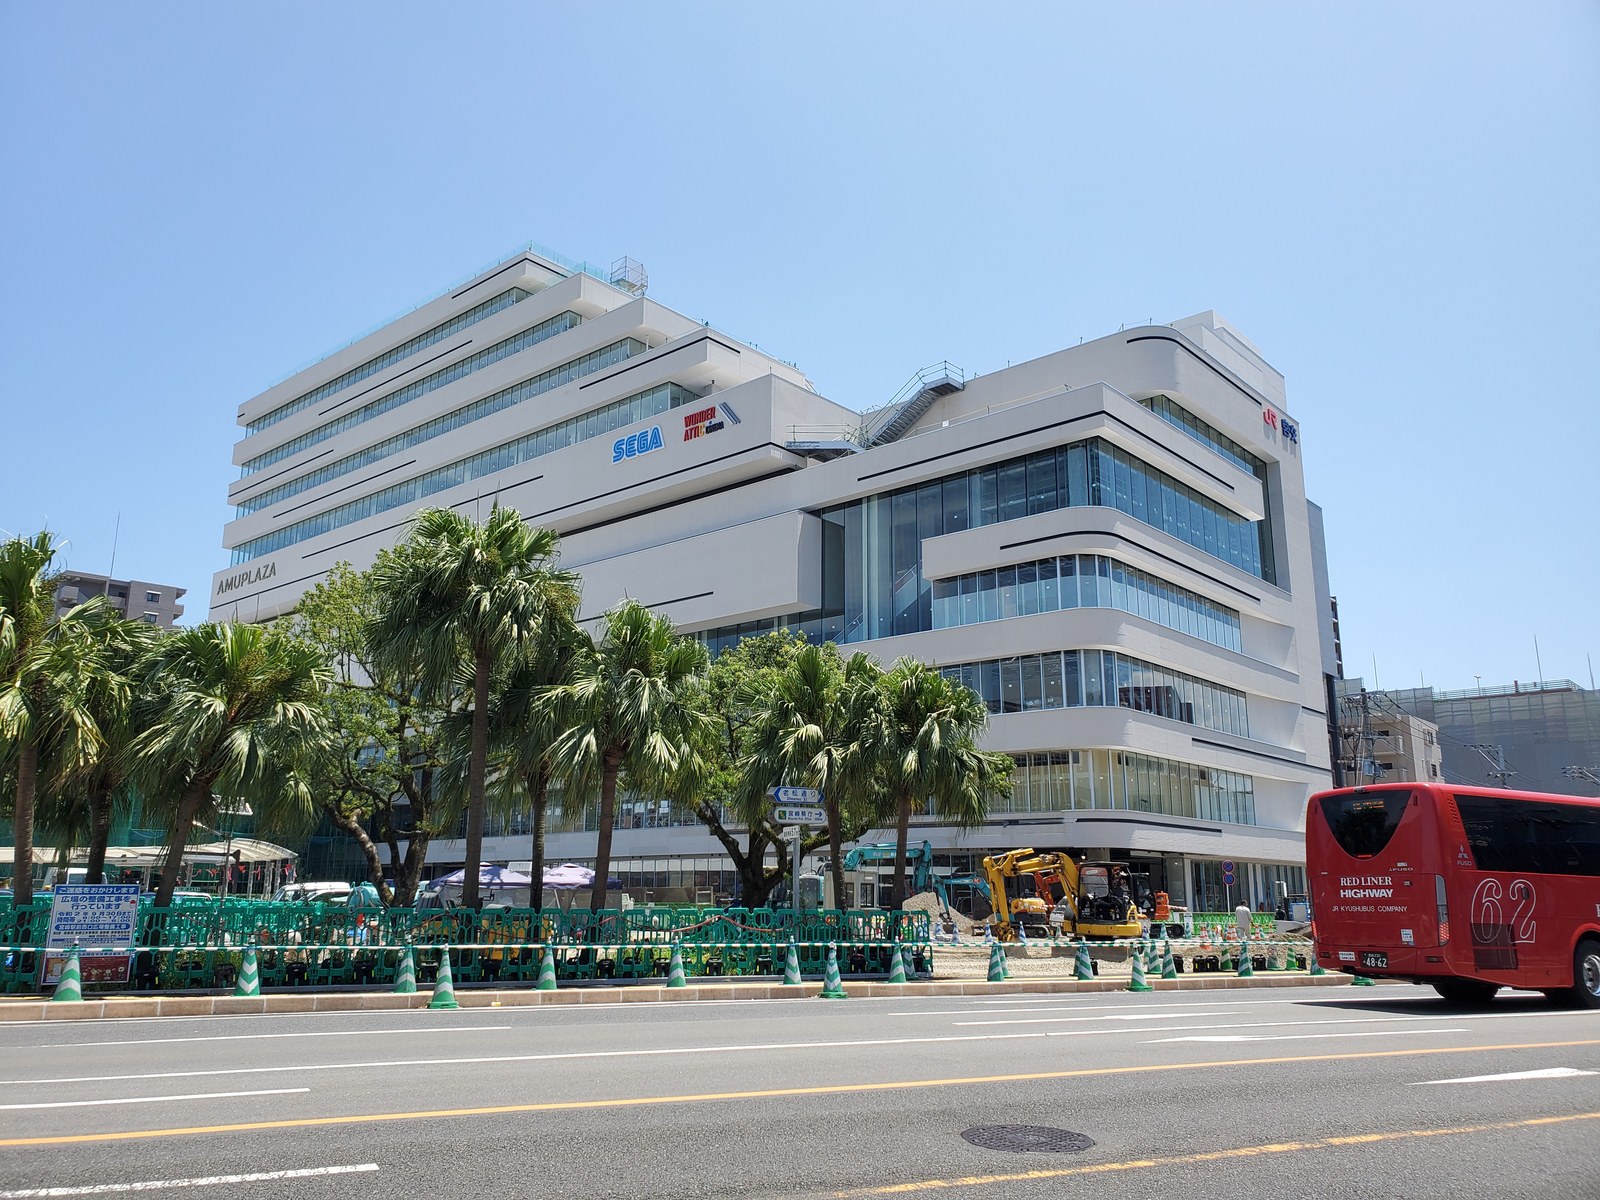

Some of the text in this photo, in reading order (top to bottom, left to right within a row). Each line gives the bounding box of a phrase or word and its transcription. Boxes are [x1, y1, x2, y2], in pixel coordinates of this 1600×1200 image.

[684, 406, 716, 428] WONDER
[1263, 409, 1277, 430] JR
[684, 423, 705, 442] ATTIC
[612, 425, 665, 464] SEGA
[217, 562, 276, 595] AMUPLAZA
[783, 789, 816, 797] 老松通り
[1340, 877, 1360, 886] RED
[1361, 876, 1393, 886] LINER
[61, 895, 131, 903] 広場の整備工事を
[1340, 889, 1393, 898] HIGHWAY
[1471, 878, 1536, 944] 62
